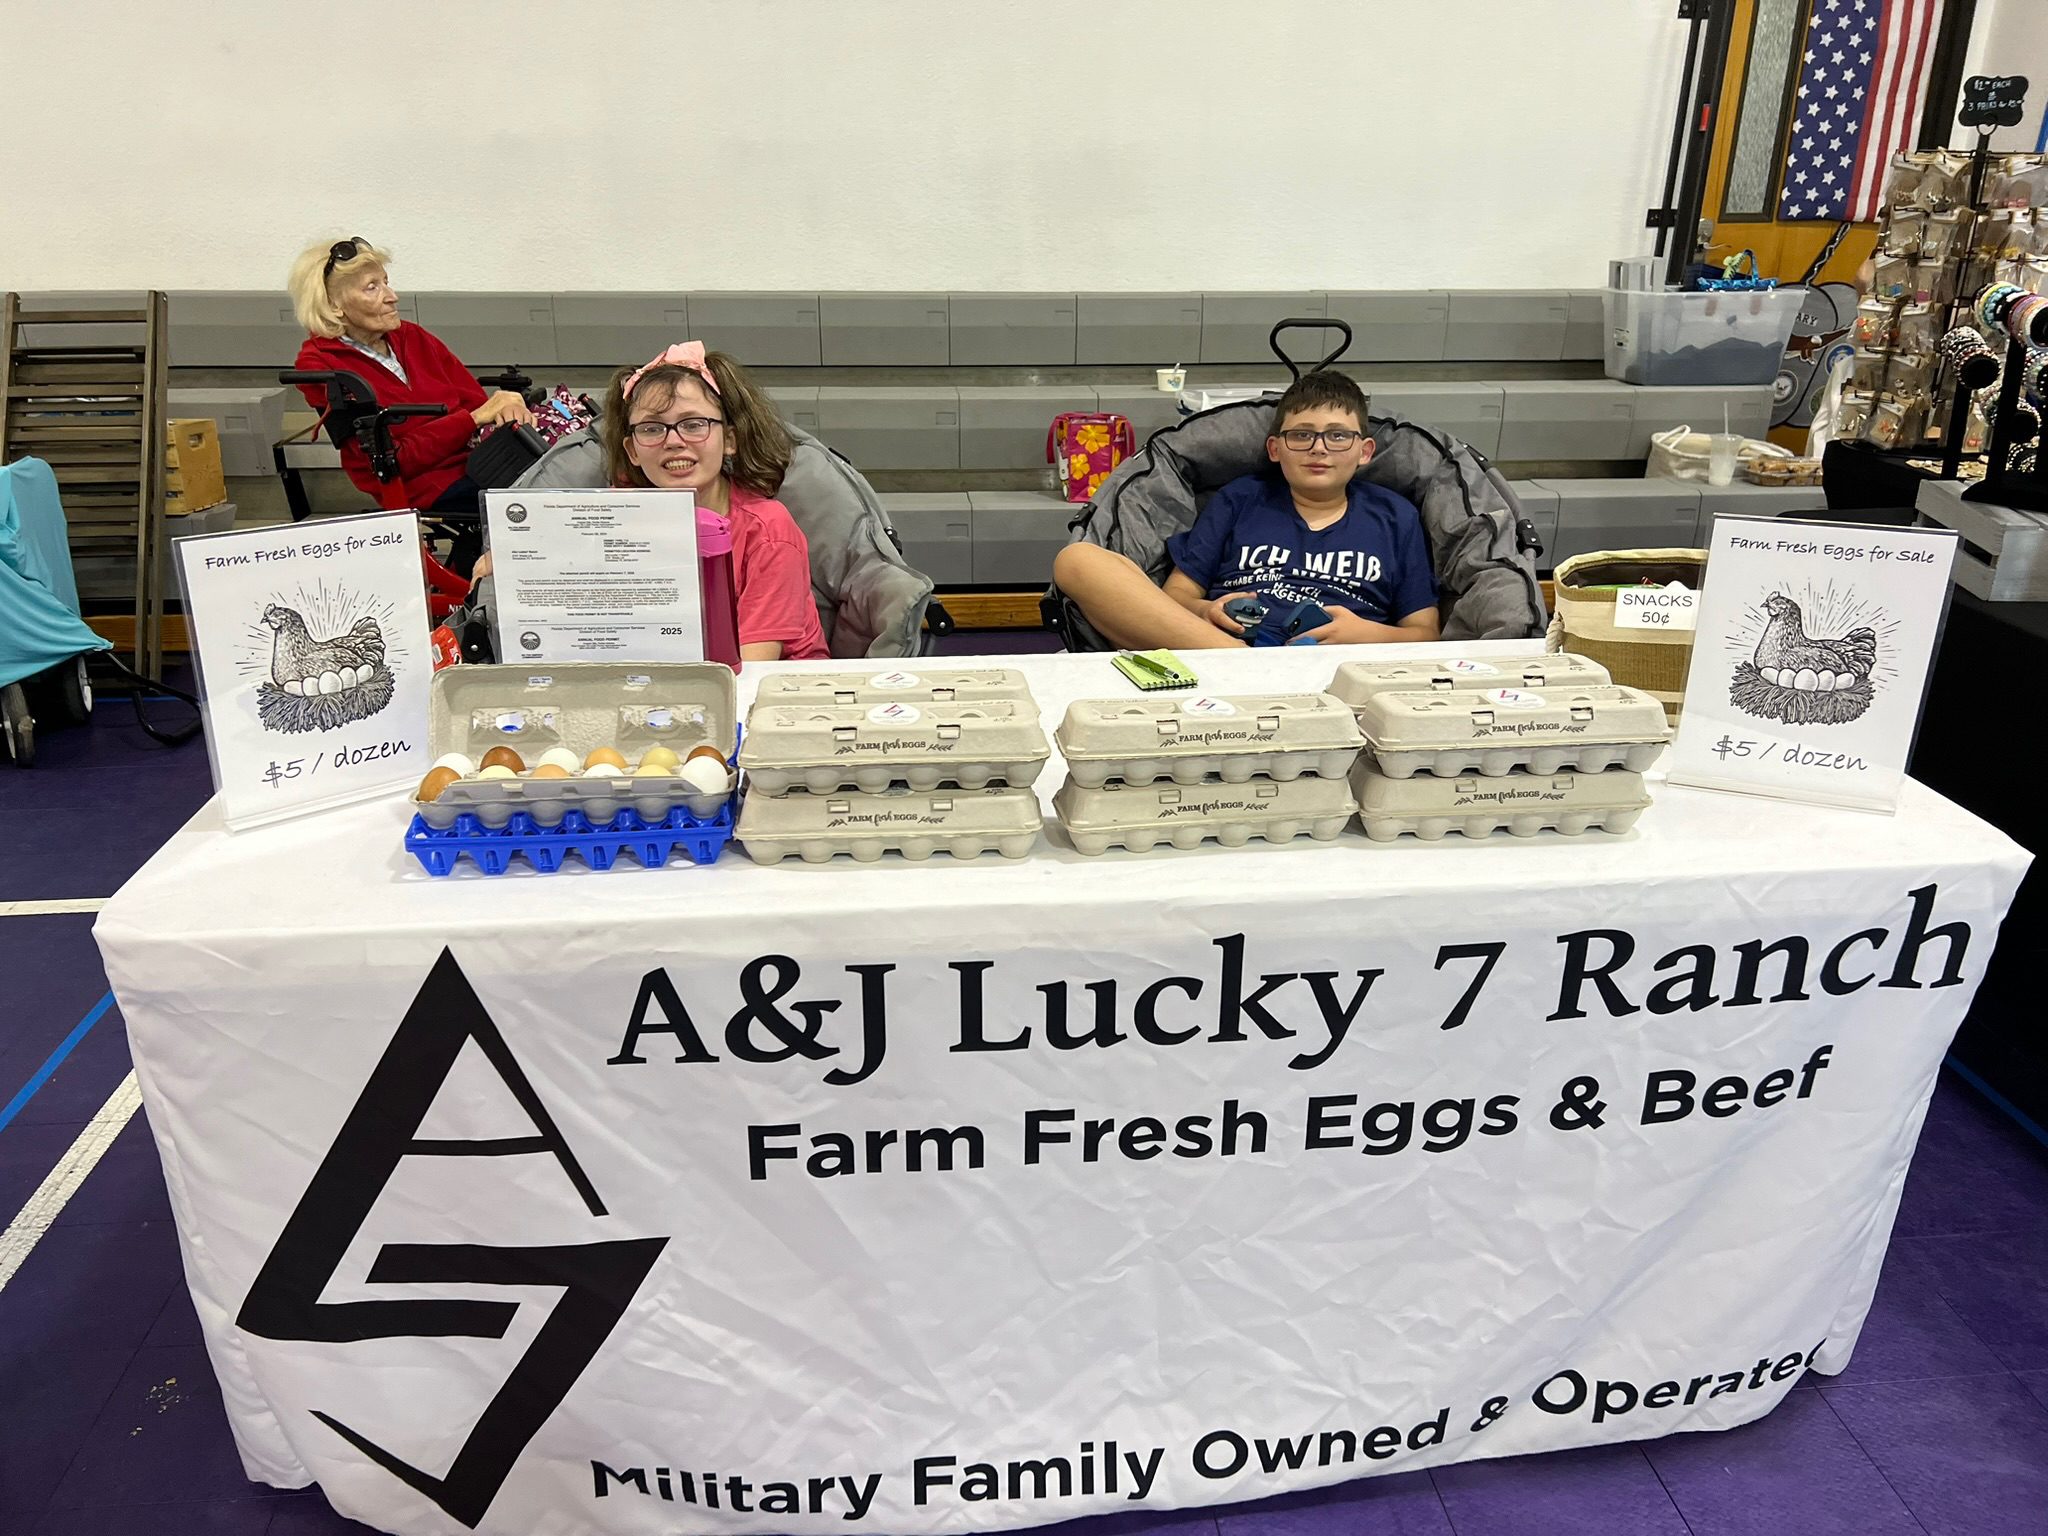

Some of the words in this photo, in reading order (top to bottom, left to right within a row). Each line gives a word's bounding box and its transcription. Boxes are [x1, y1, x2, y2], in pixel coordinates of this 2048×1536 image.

[206, 554, 250, 570] Farm
[255, 547, 296, 564] Fresh
[302, 542, 341, 558] Eggs
[345, 536, 366, 553] for
[369, 532, 403, 546] Sale
[1239, 545, 1291, 570] ICH
[1730, 537, 1772, 550] Farm
[1777, 540, 1818, 554] Fresh
[1824, 544, 1864, 560] Eggs
[1868, 546, 1894, 563] for
[1896, 550, 1934, 564] Sale
[1622, 594, 1692, 608] SNACKS
[1642, 612, 1670, 626] 50¢
[1179, 733, 1204, 742] FARM
[1204, 730, 1223, 745] fresh
[1223, 732, 1247, 740] EGGS
[1492, 725, 1516, 733] FARM
[1517, 720, 1536, 736] fresh
[1536, 722, 1560, 730] EGGS
[856, 742, 880, 750] FARM
[882, 738, 900, 754] fresh
[1711, 735, 1758, 761] $5
[1759, 742, 1776, 760] /
[1783, 743, 1868, 771] dozen
[262, 760, 305, 788] $5
[312, 752, 324, 774] /
[334, 740, 412, 768] dozen
[1473, 792, 1497, 801] FARM
[1498, 788, 1516, 804] fresh
[1177, 804, 1201, 812] FARM
[1202, 800, 1220, 815] fresh
[1220, 802, 1244, 810] EGGS
[848, 814, 873, 823] FARM
[874, 810, 892, 826] fresh
[893, 813, 918, 821] EGGS
[607, 954, 896, 1086] A&J
[948, 932, 1385, 1070] Lucky
[1433, 941, 1507, 1031] 7
[1546, 883, 1971, 1022] Ranch
[748, 1122, 984, 1181] Farm
[1024, 1099, 1268, 1165] Fresh
[1305, 1094, 1520, 1156] Eggs
[1549, 1075, 1608, 1130] &
[1640, 1045, 1834, 1126] Beef
[590, 1458, 883, 1521] Military
[913, 1440, 1165, 1505] Family
[1191, 1405, 1451, 1481] Owned
[1470, 1395, 1509, 1433] &
